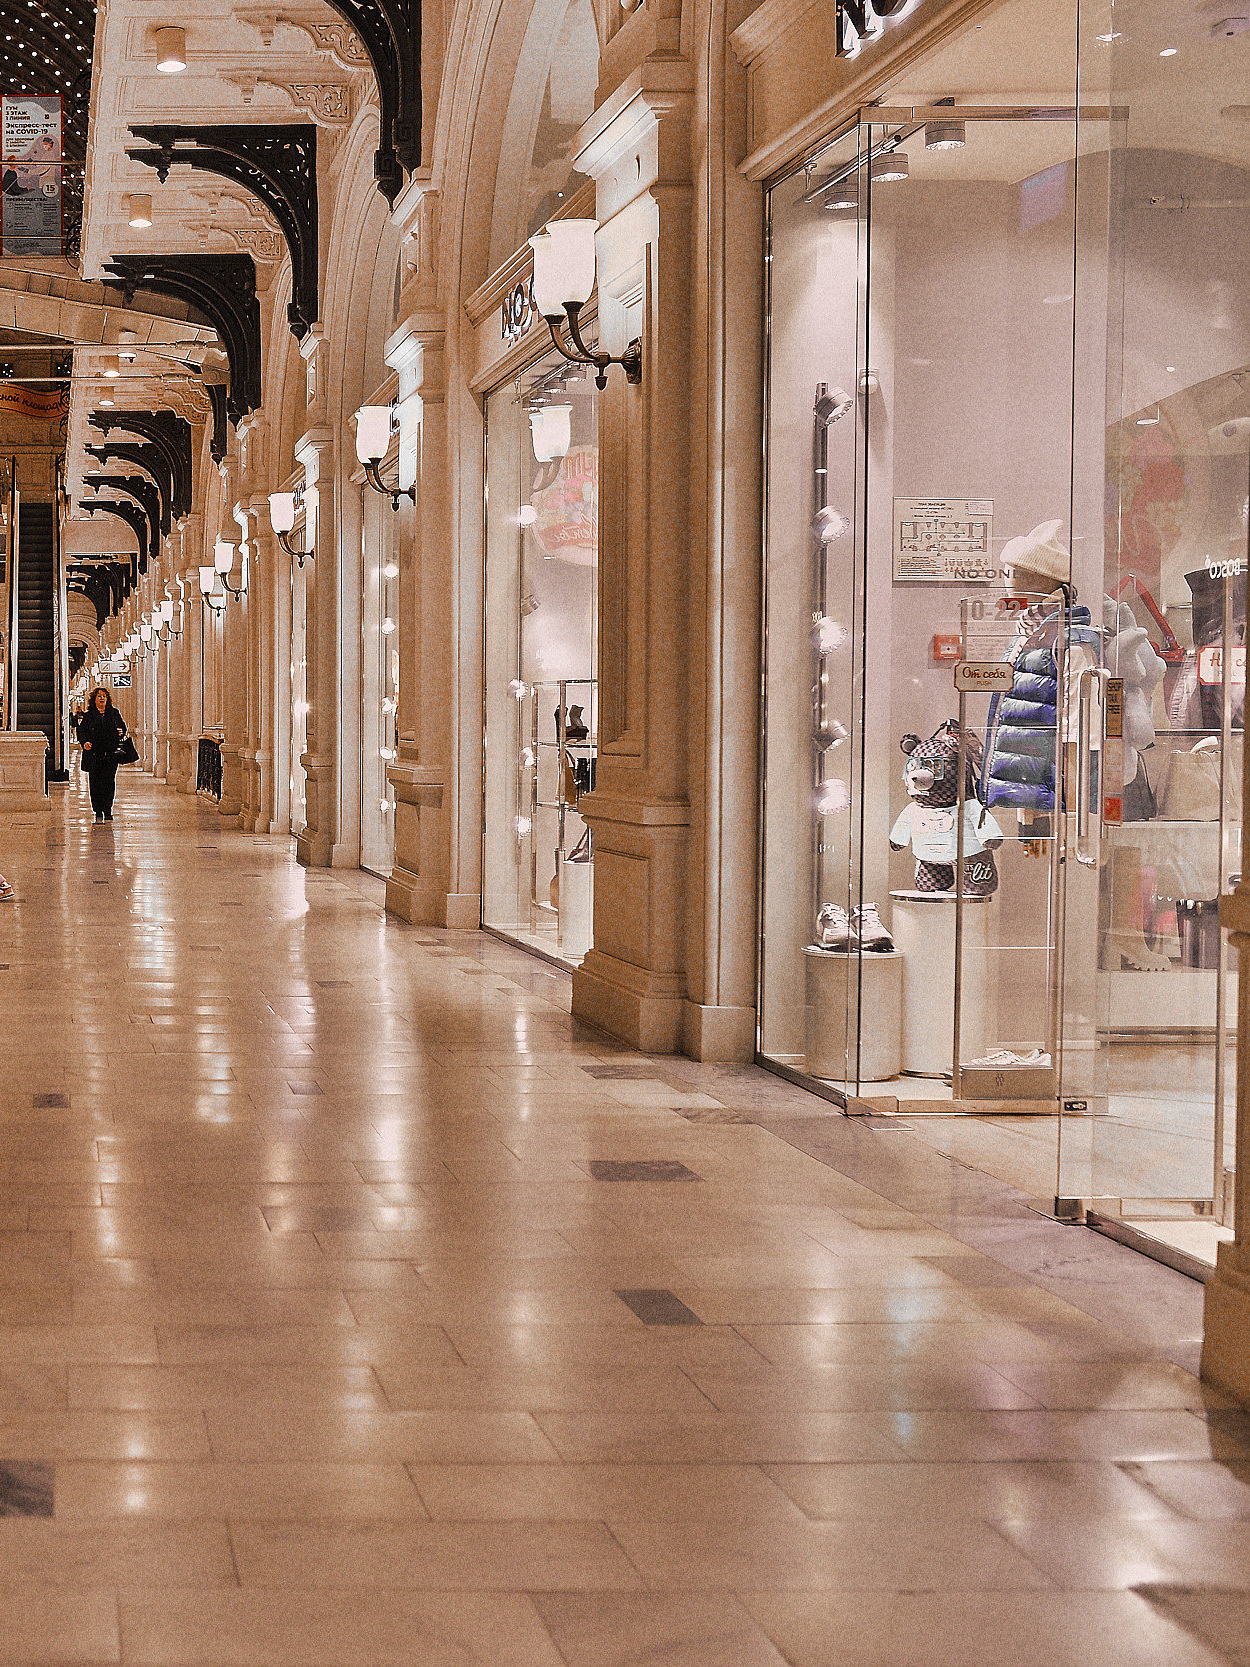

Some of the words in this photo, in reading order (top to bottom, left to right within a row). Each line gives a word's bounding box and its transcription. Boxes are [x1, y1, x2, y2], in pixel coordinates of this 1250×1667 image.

[22, 397, 61, 412] площад
[954, 569, 979, 579] NO
[962, 666, 981, 678] От
[982, 668, 1007, 679] себя
[972, 862, 993, 881] lit
